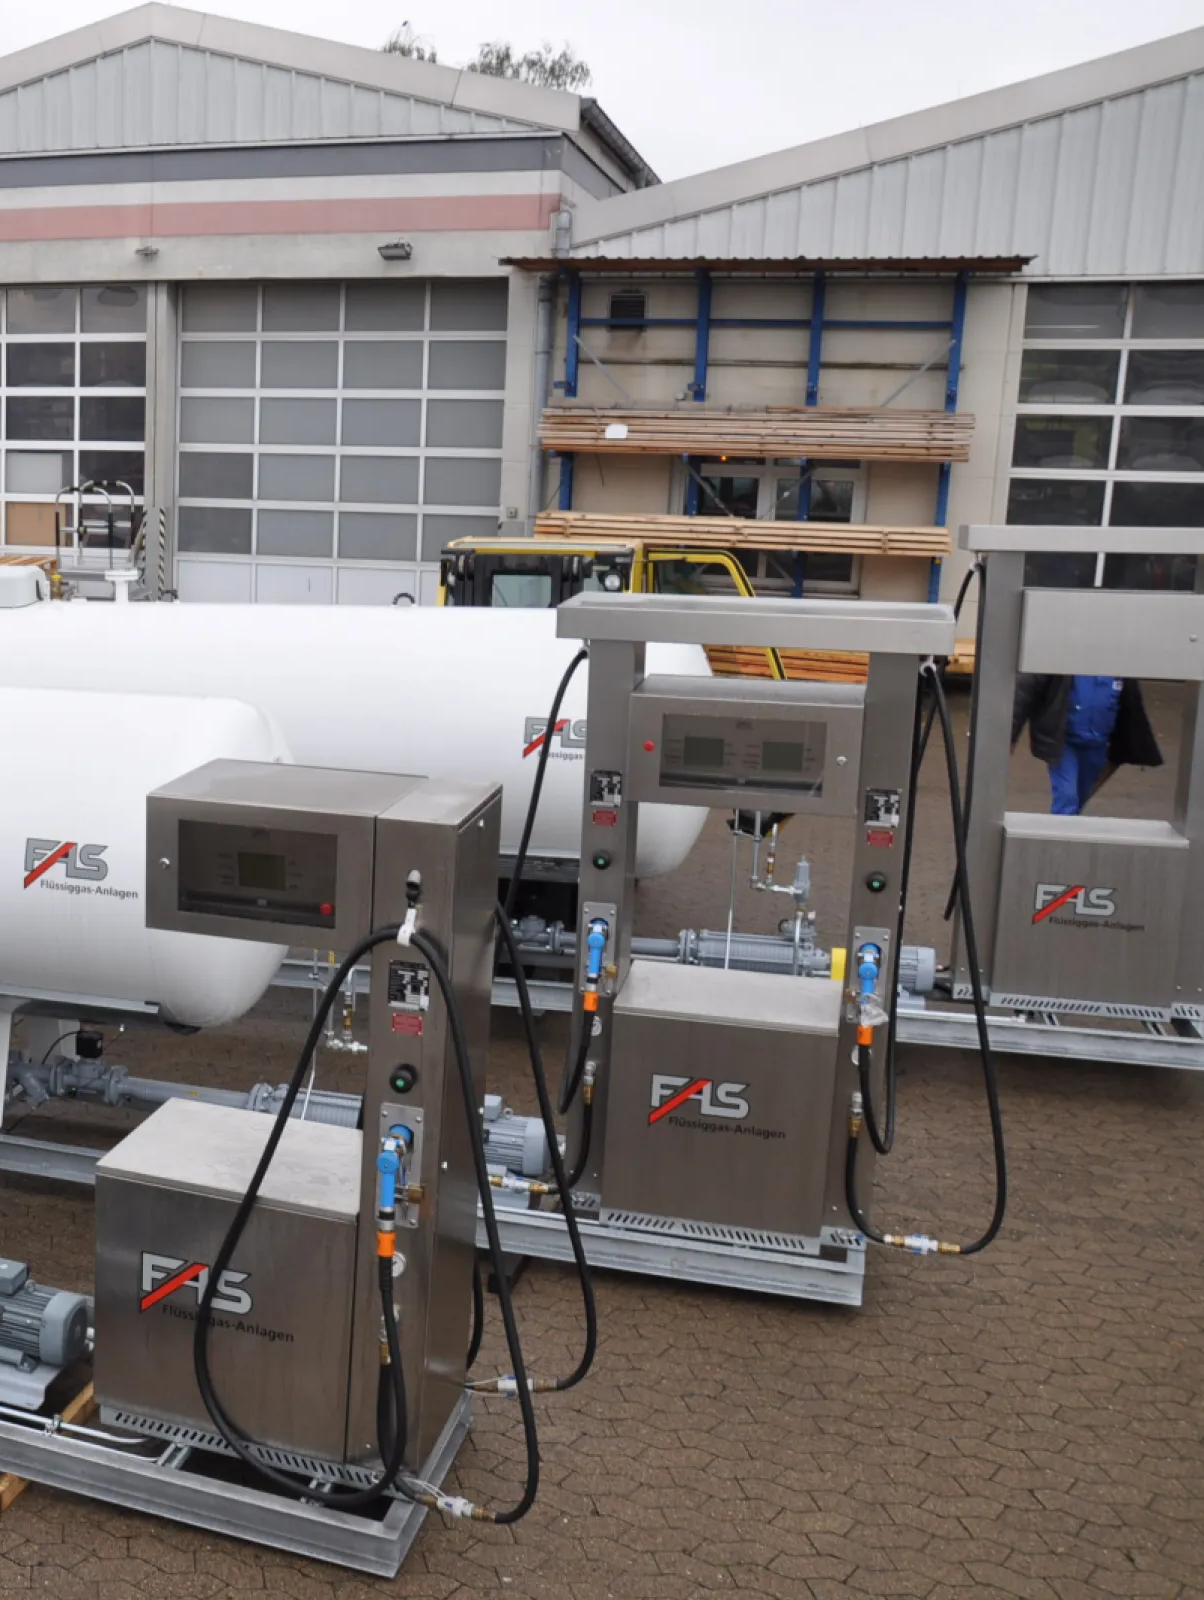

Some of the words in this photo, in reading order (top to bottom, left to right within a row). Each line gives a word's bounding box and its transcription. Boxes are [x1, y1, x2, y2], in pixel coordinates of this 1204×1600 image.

[24, 837, 109, 889] FAS
[40, 878, 139, 900] Flüssiggas-Anlagen
[1032, 882, 1116, 925] FAS
[648, 1073, 750, 1127] FAS
[668, 1115, 786, 1140] Flüssiggas-Anlagen
[139, 1250, 255, 1315] FAS
